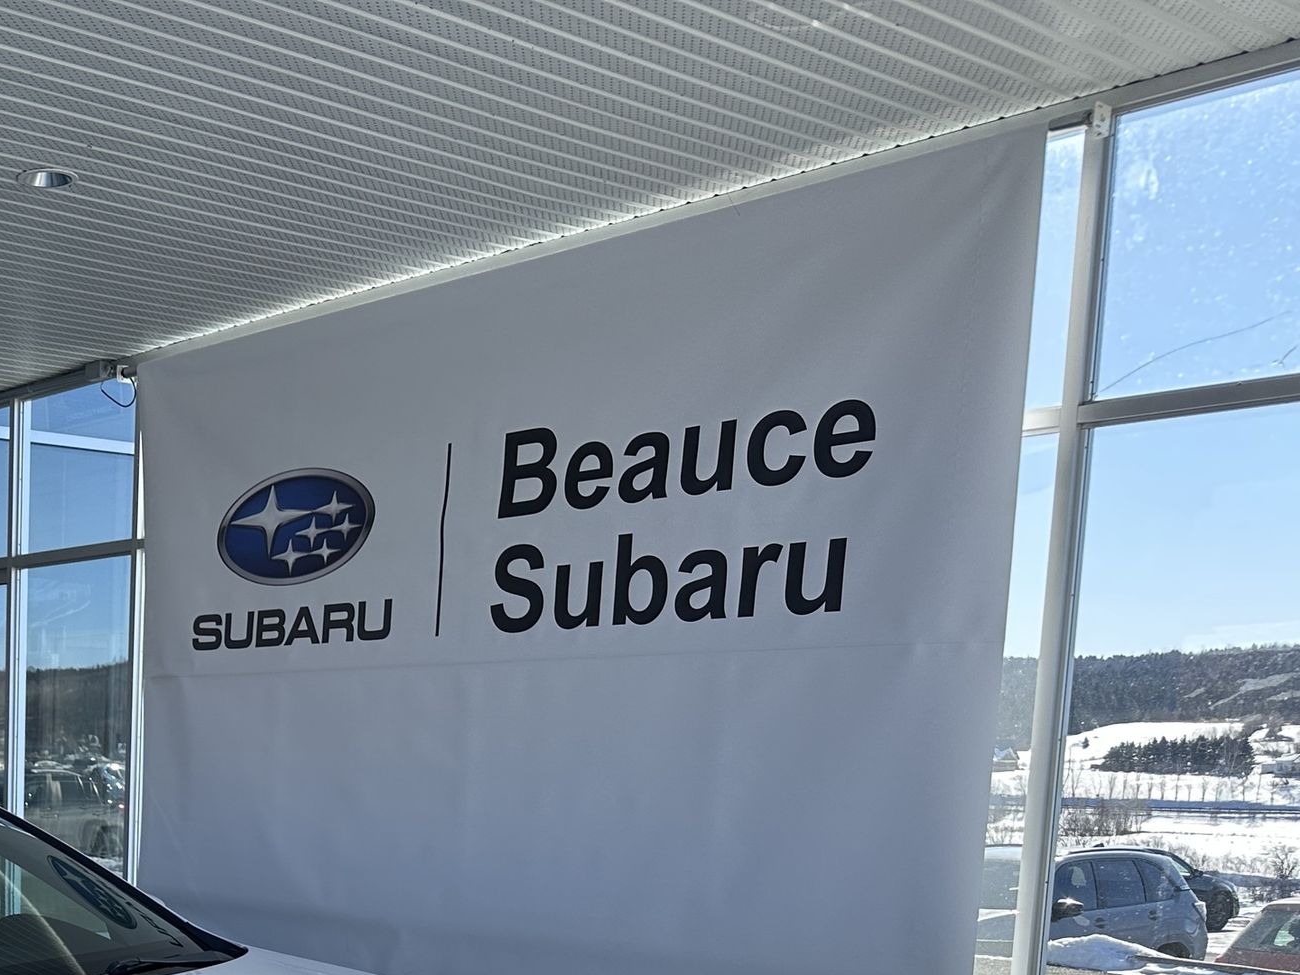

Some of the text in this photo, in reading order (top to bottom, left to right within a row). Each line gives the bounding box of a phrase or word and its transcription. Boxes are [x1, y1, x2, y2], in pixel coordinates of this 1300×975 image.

[497, 398, 877, 519] Beauce
[191, 598, 393, 651] SUBARU
[489, 534, 848, 634] Subaru
